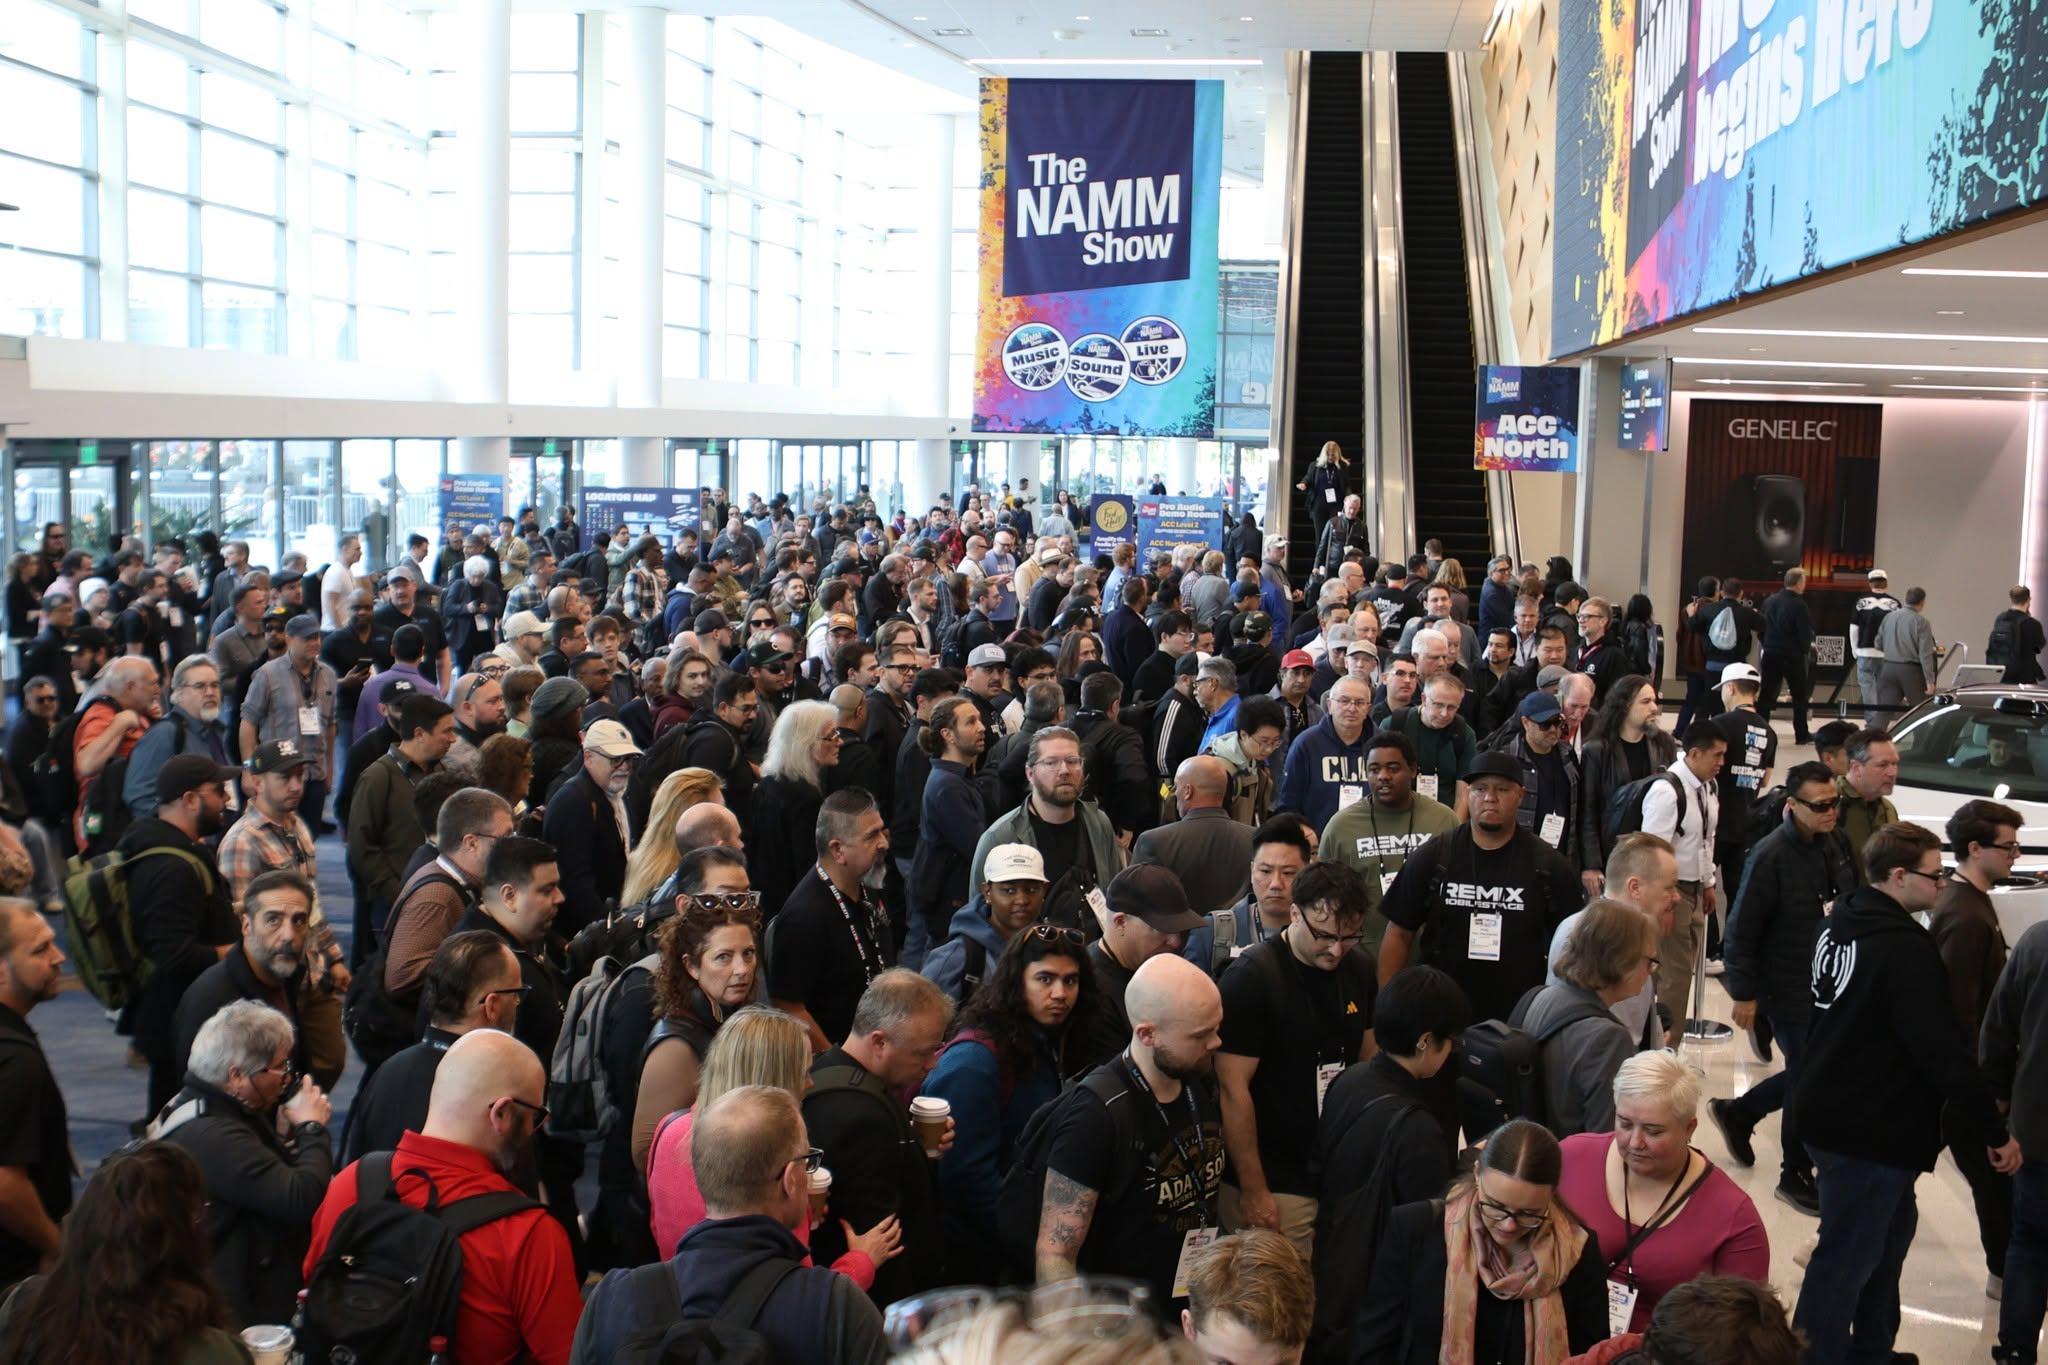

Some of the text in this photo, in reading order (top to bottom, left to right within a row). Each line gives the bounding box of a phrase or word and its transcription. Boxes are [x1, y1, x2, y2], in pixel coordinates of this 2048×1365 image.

[1693, 15, 1806, 186] begins
[1028, 152, 1087, 187] The
[1016, 174, 1180, 238] NAMM
[1082, 231, 1174, 266] Show
[1011, 347, 1060, 367] Music
[1136, 344, 1169, 357] Live
[1070, 359, 1123, 376] Sound
[1488, 381, 1520, 393] NAMM
[1496, 414, 1558, 436] ACC
[1728, 418, 1832, 441] GENELEC
[1483, 437, 1569, 459] North
[585, 492, 657, 502] LOCATOR MAP
[1159, 503, 1176, 511] Pro
[1177, 504, 1205, 512] Audio
[1187, 511, 1219, 519] Rooms
[1356, 833, 1433, 854] REMIX
